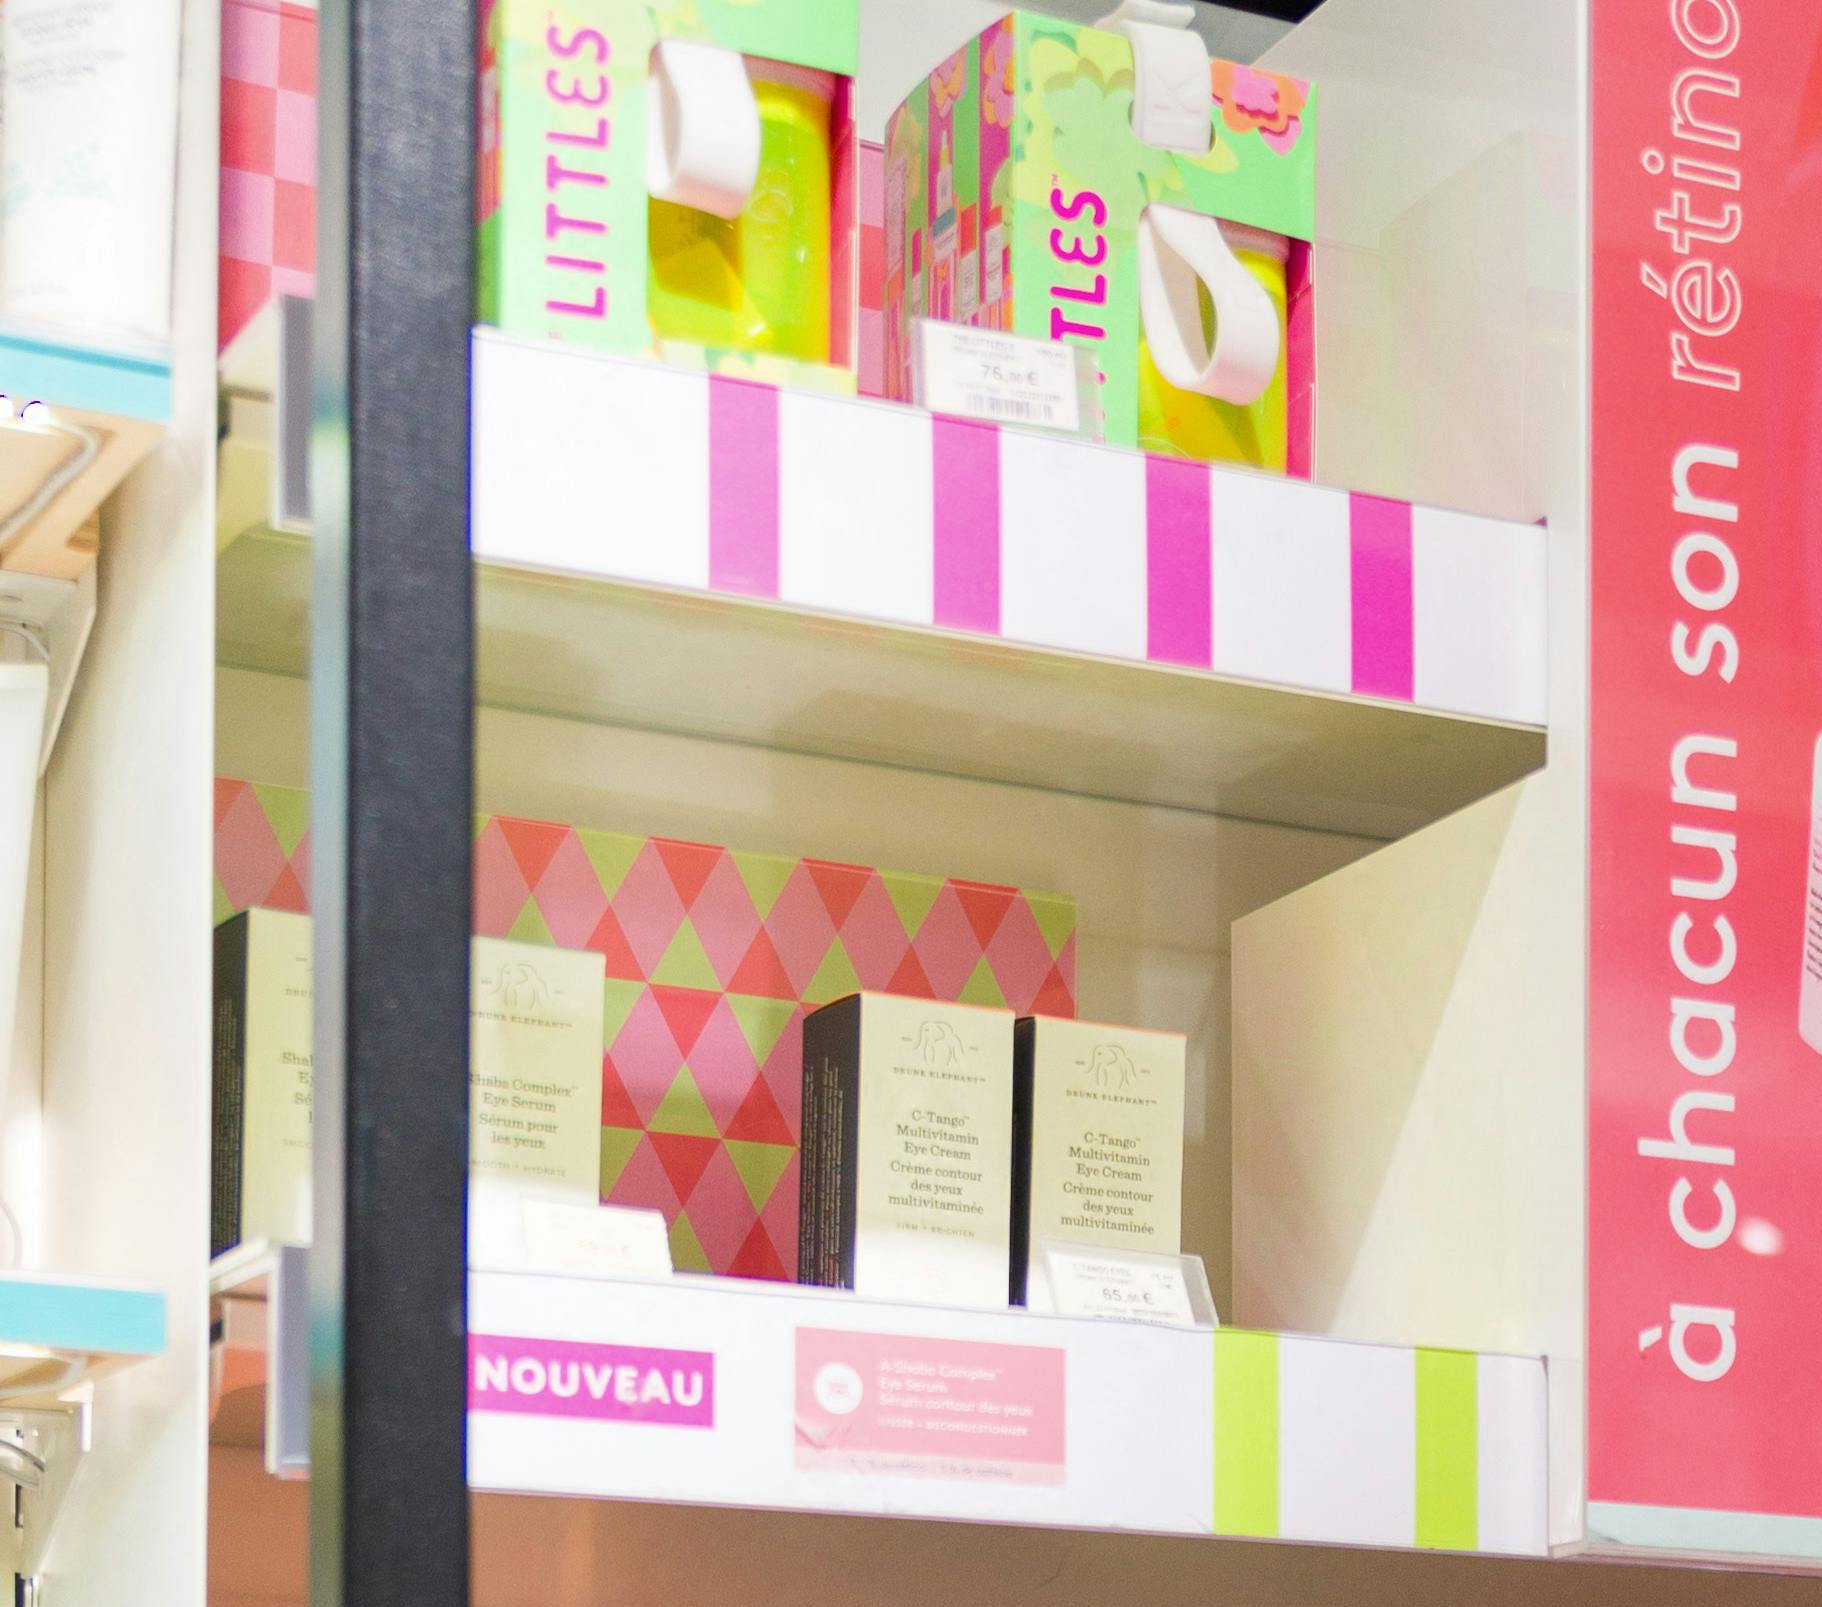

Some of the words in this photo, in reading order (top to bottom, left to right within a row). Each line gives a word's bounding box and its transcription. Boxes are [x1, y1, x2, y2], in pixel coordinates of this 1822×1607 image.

[1049, 188, 1108, 342] TLES
[1669, 444, 1741, 685] son
[1636, 733, 1738, 1249] chacun
[897, 1124, 979, 1146] Multivitamin
[904, 1142, 927, 1156] Eye
[930, 1144, 971, 1162] Cream
[890, 1160, 933, 1176] Crème
[935, 1166, 982, 1182] contour
[910, 1179, 931, 1193] des
[933, 1183, 963, 1197] yeux
[888, 1194, 984, 1216] multivitaminée
[1639, 1303, 1740, 1382] à
[474, 1355, 704, 1408] NOUVEAU
